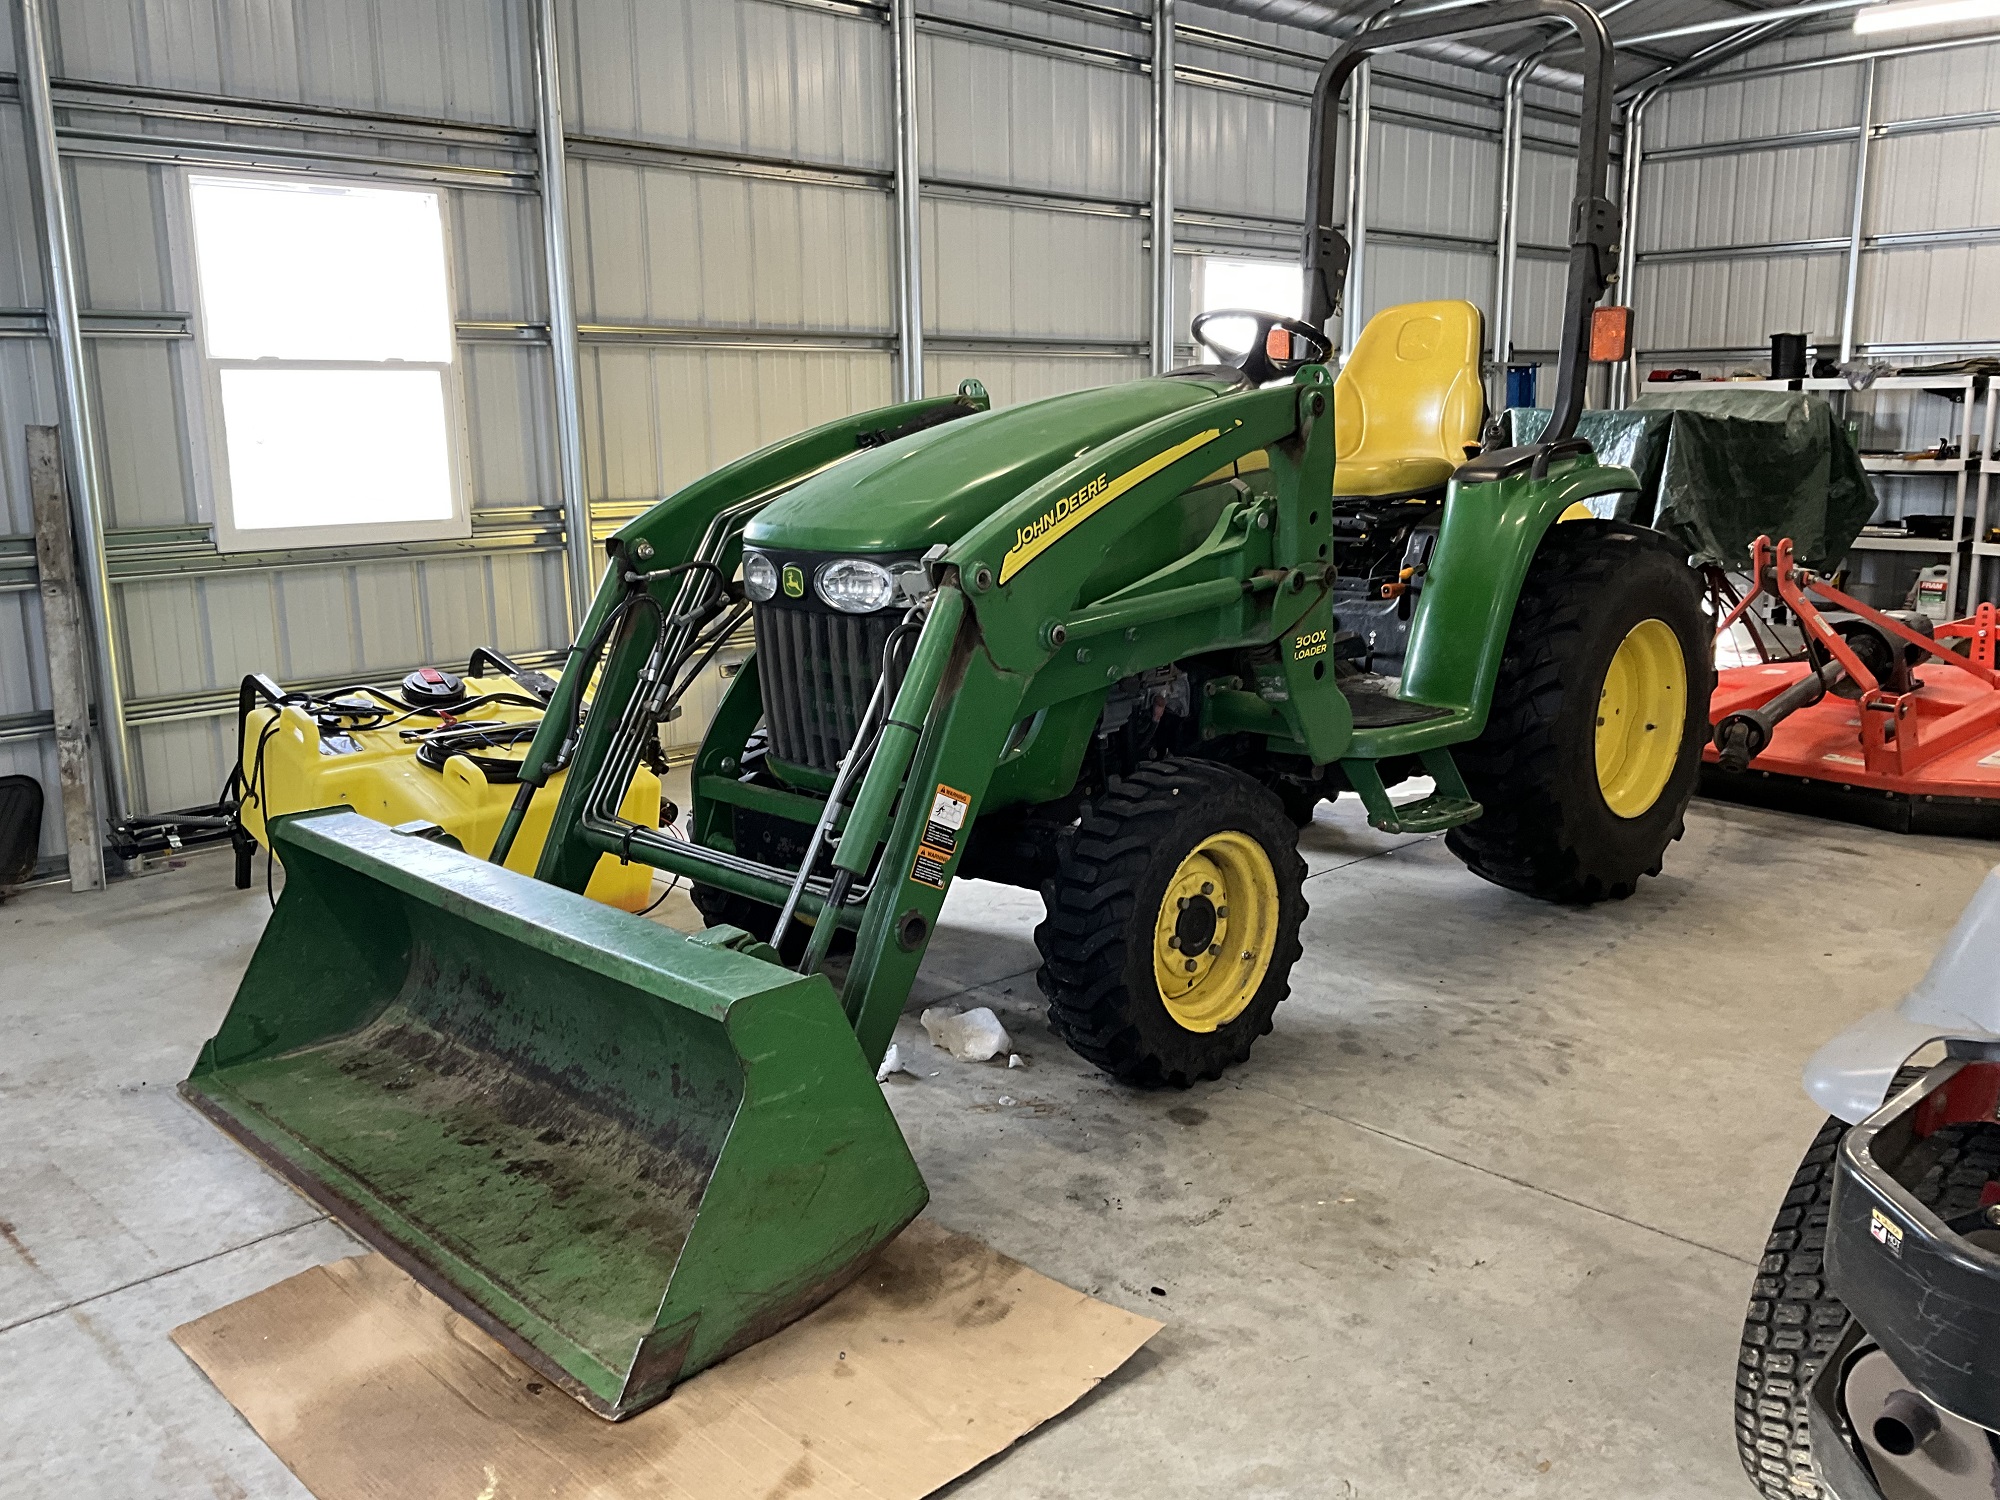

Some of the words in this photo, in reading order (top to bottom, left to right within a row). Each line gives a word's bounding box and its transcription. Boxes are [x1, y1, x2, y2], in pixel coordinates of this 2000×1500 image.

[1012, 509, 1056, 552] JOHN
[1055, 472, 1109, 522] DEERE
[1295, 629, 1327, 649] 300X
[1294, 643, 1327, 660] LOADER
[945, 789, 967, 802] WARNING
[1887, 1231, 1902, 1249] HOT
